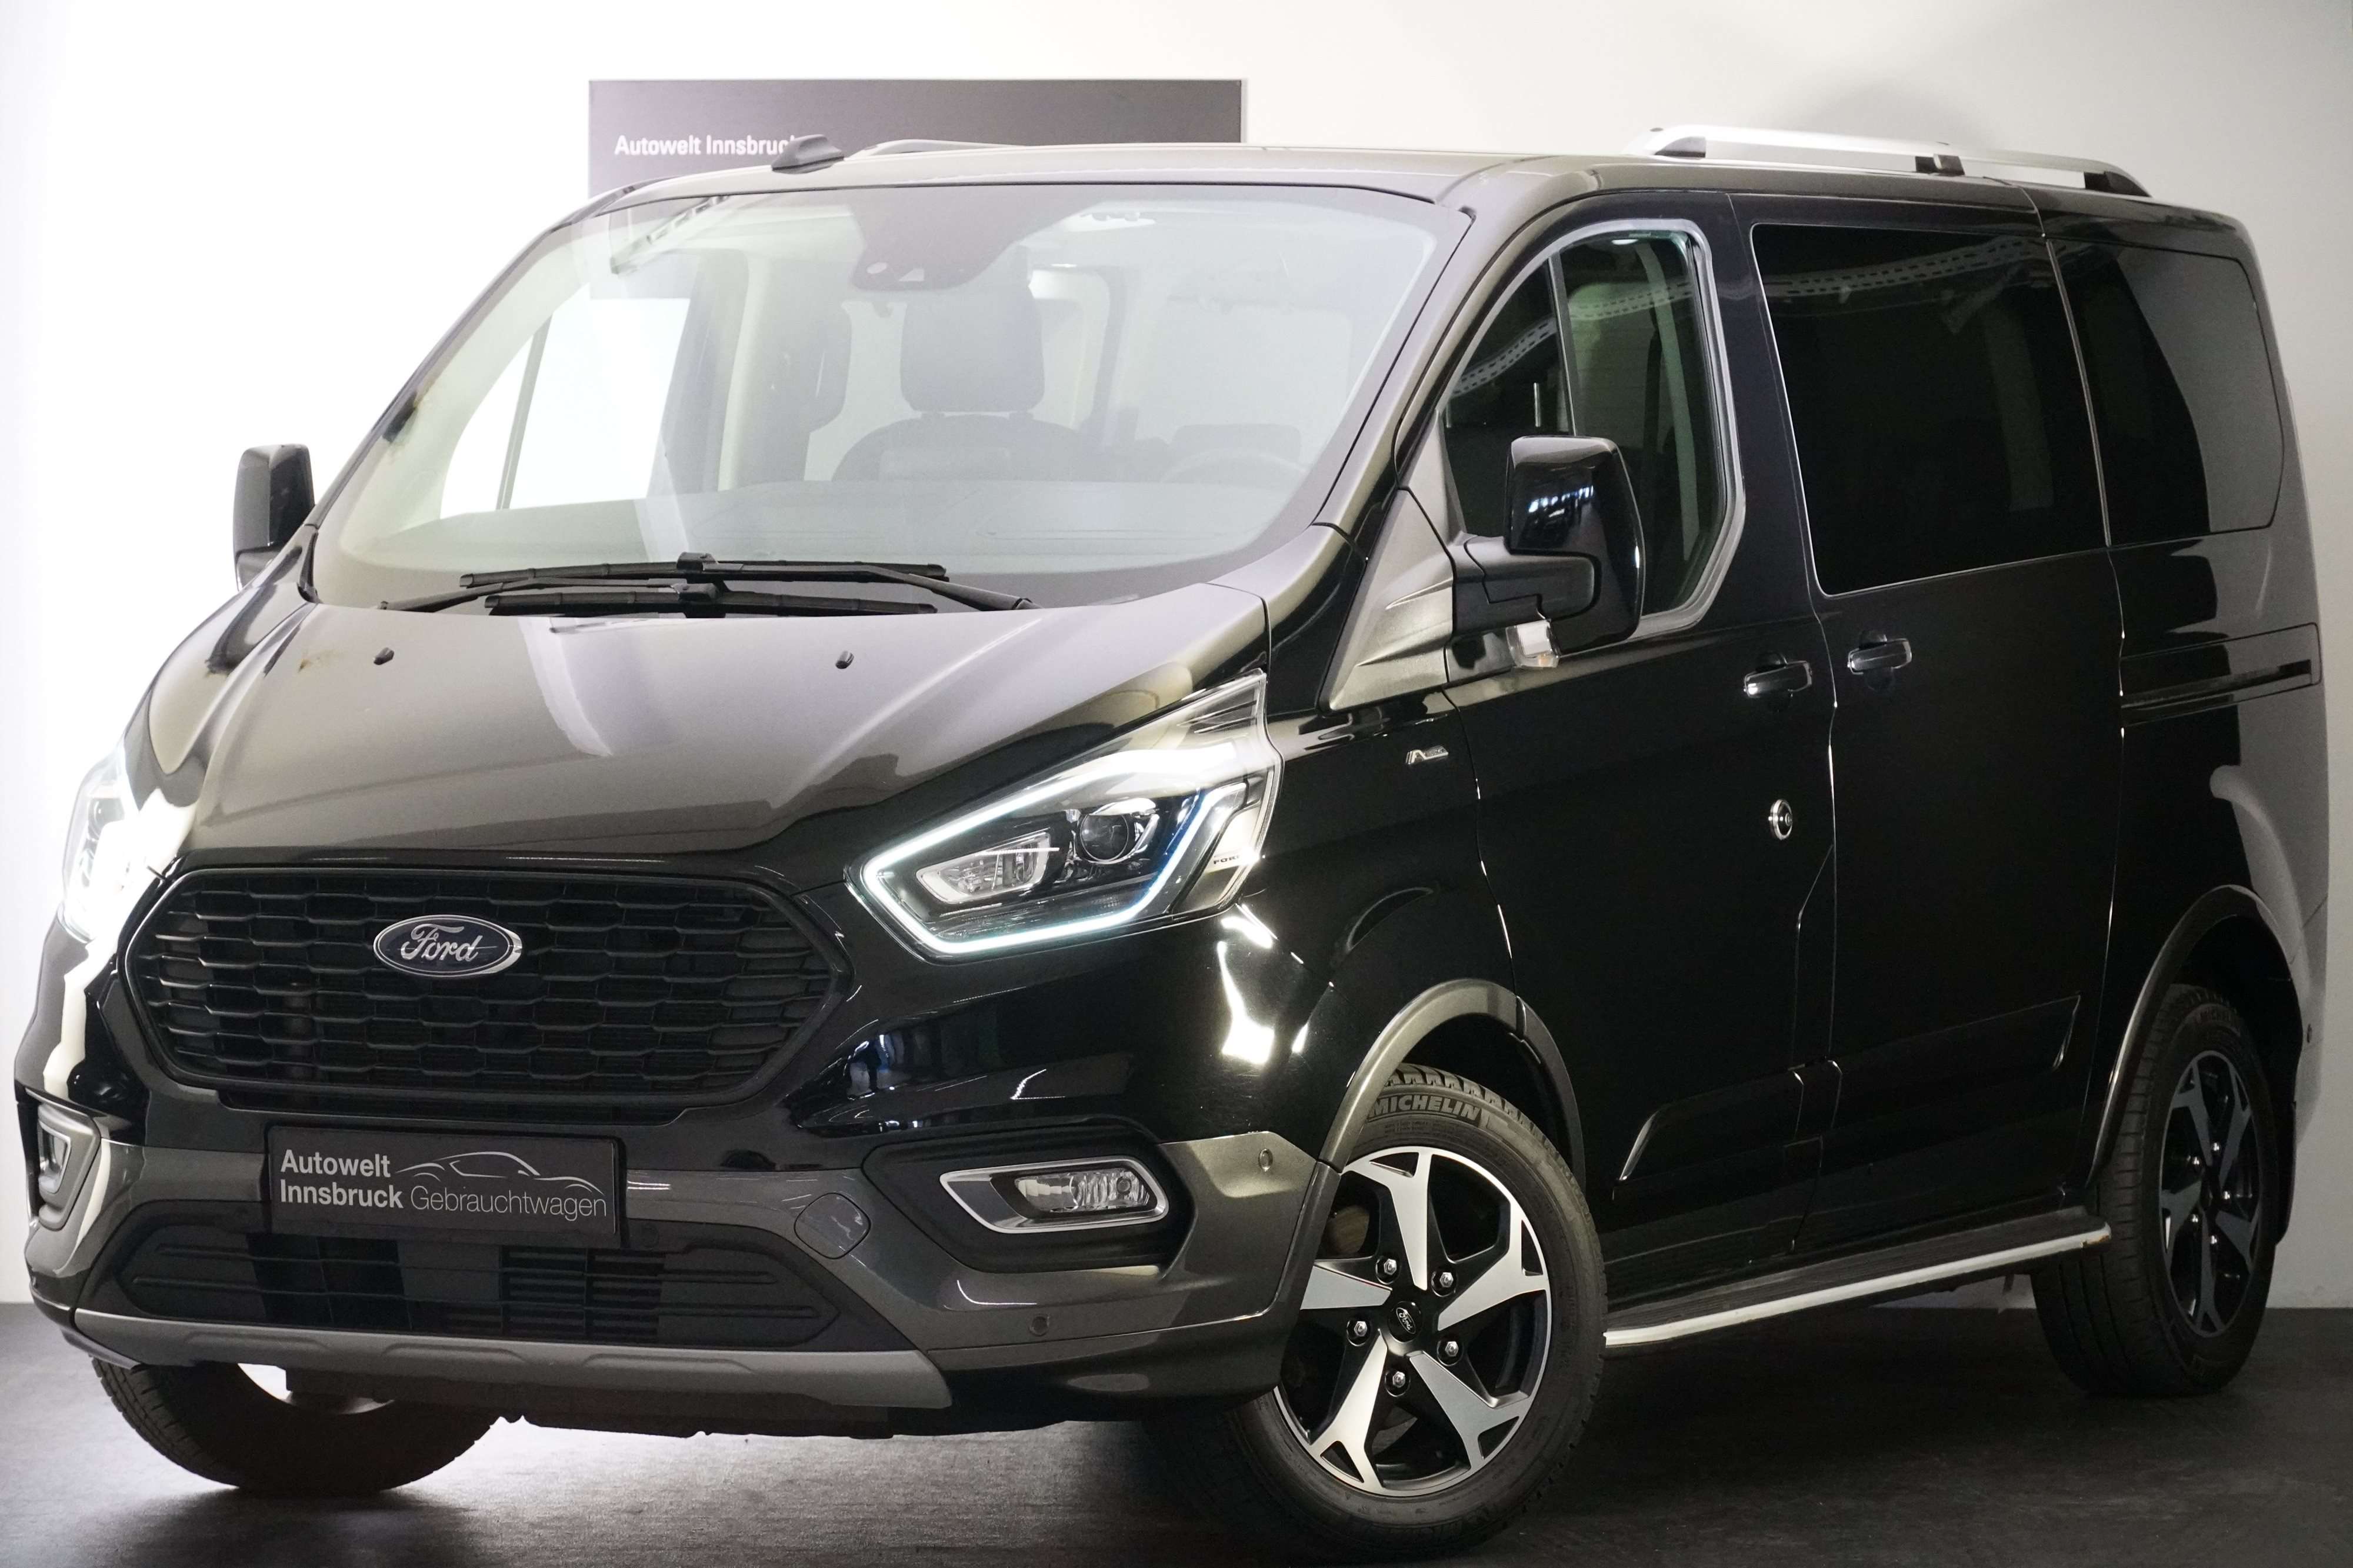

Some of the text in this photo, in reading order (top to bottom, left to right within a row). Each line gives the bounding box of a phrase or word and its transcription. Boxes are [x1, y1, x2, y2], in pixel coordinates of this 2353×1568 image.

[614, 135, 795, 156] Autowelt Innsbruc
[401, 923, 484, 962] Ford
[1371, 1095, 1480, 1120] MICHELIN
[281, 1149, 391, 1177] Autowelt
[280, 1179, 607, 1222] Innsbruck Gebrauchtwagen
